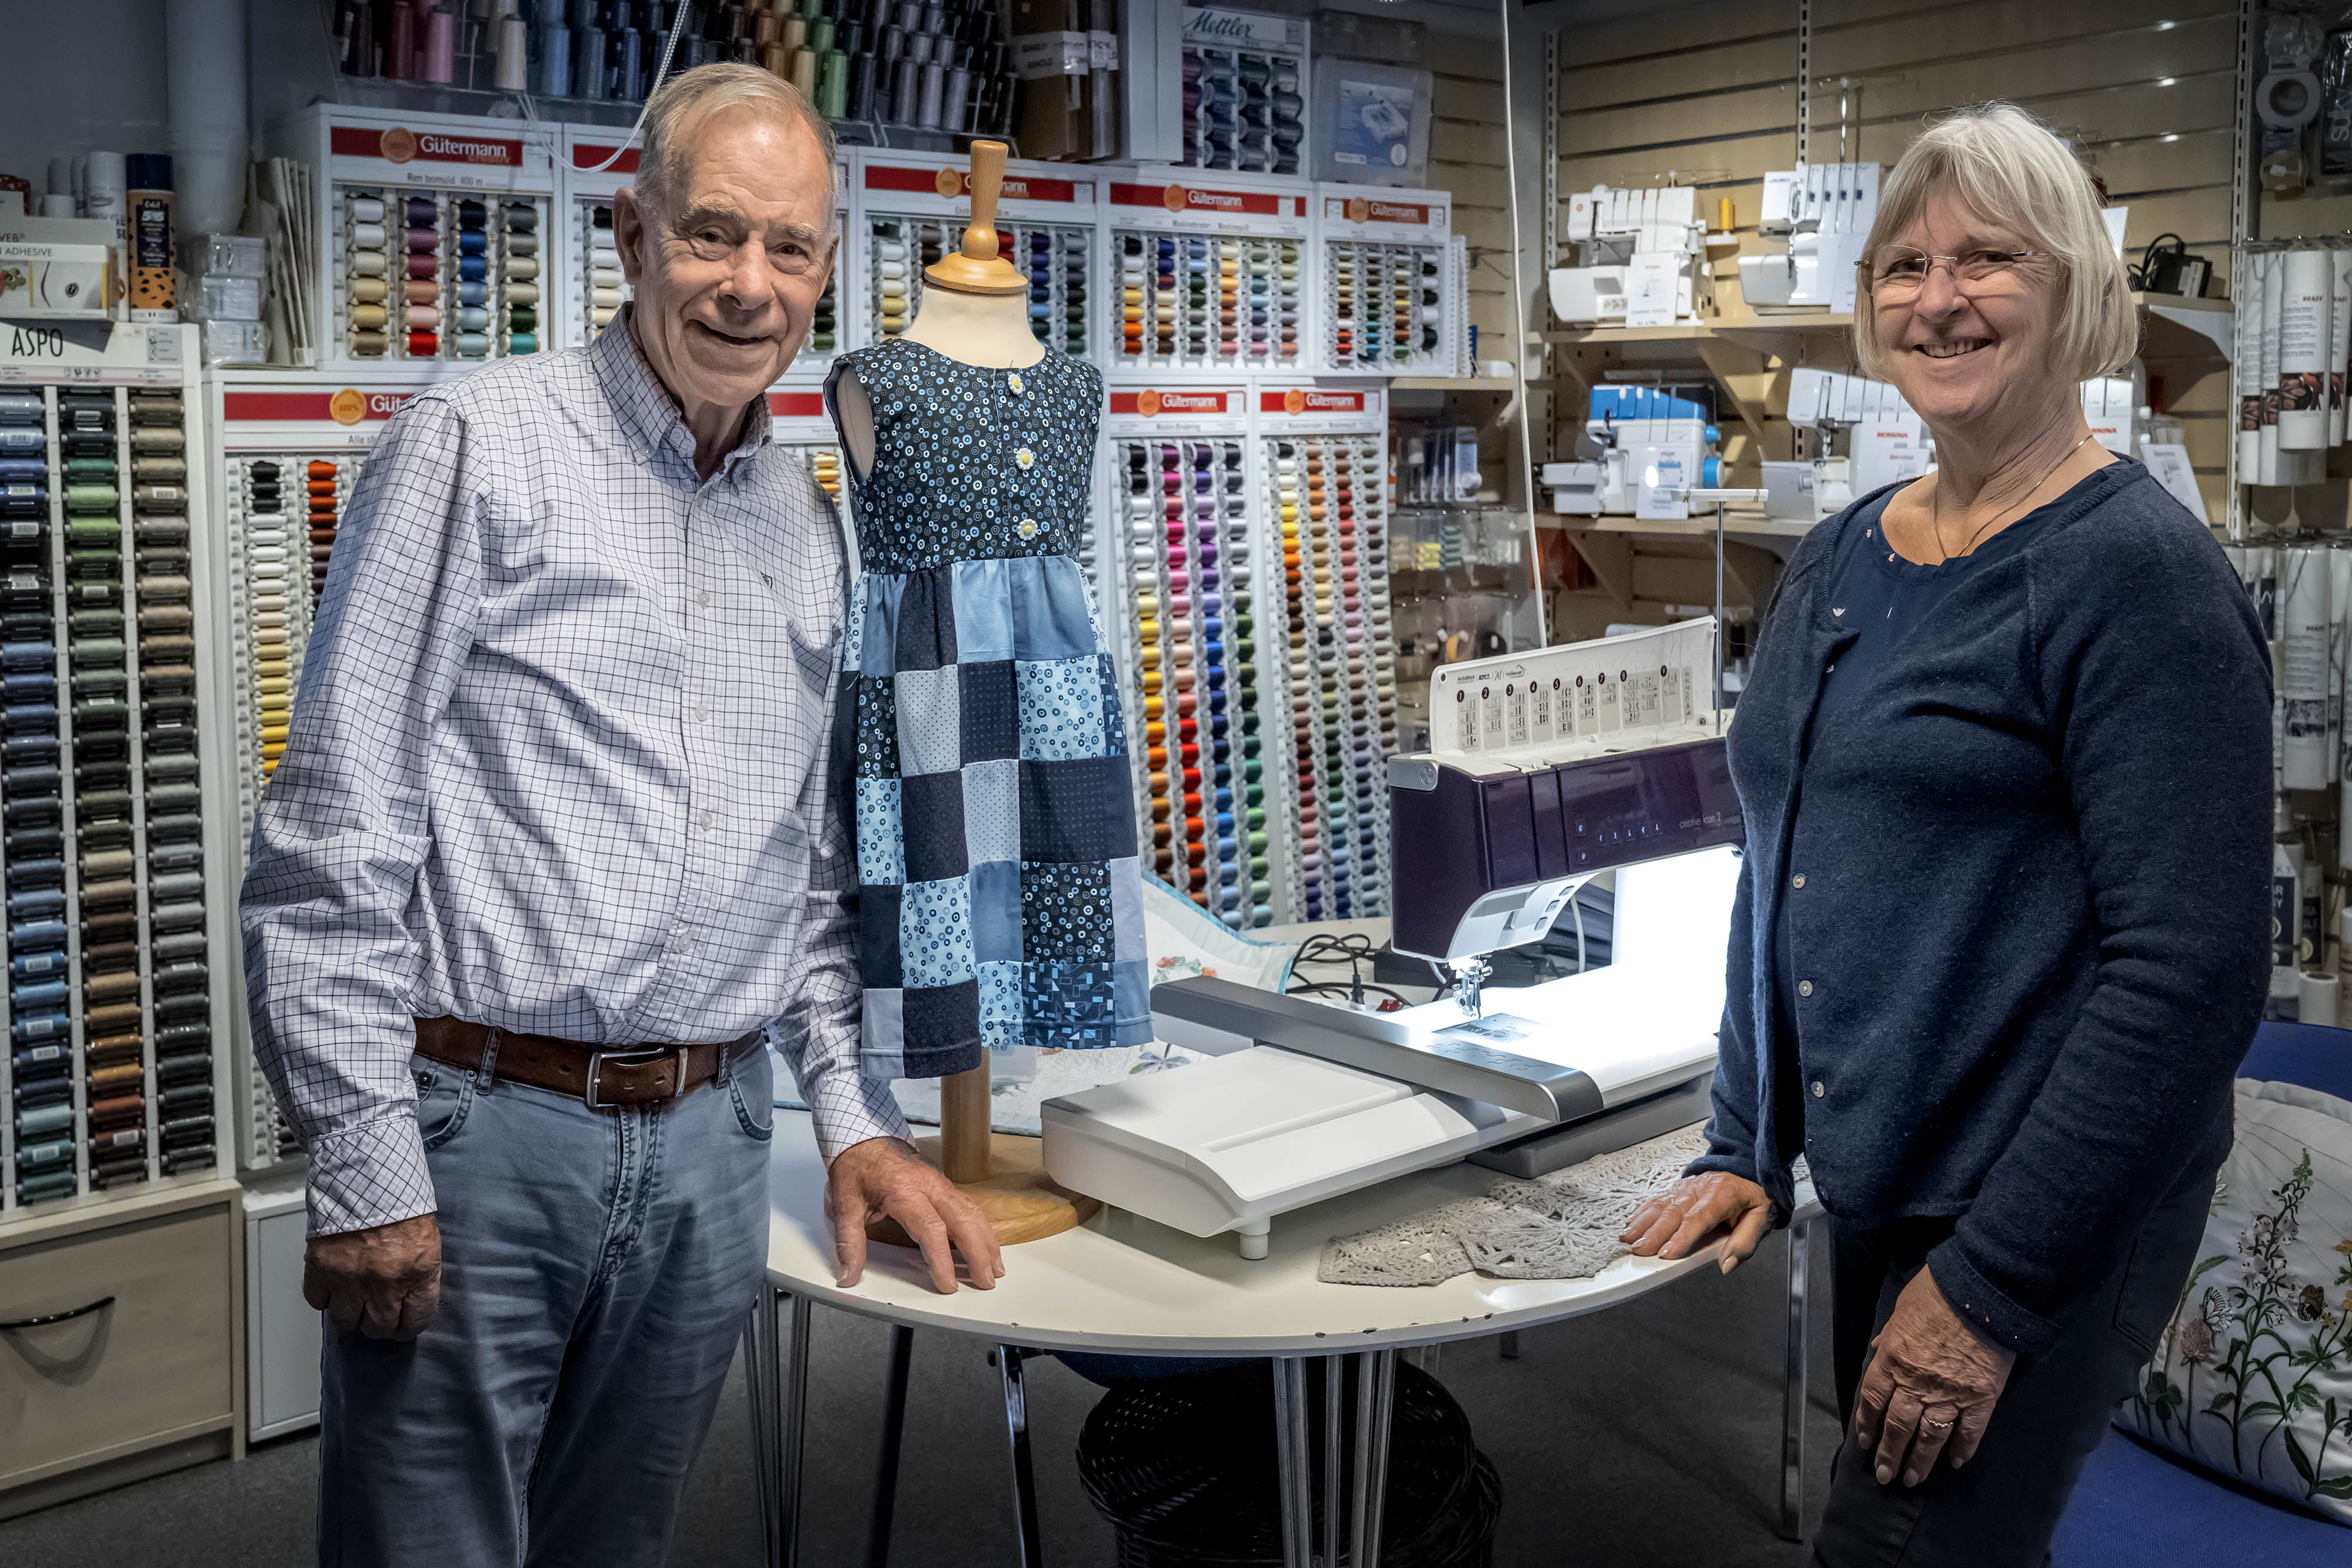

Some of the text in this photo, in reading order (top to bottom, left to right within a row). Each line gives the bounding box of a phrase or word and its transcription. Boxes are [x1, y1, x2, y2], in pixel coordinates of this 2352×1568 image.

[1182, 11, 1252, 38] Mettler
[420, 136, 507, 158] Gütermann
[1188, 190, 1242, 206] Gütermann
[5, 248, 53, 257] ADHESIVE
[12, 327, 64, 357] ASPO
[1162, 394, 1217, 407] Gütermann
[1305, 393, 1355, 407] Gütermann
[348, 434, 365, 444] Alle
[1679, 812, 1721, 828] creative icon 2
